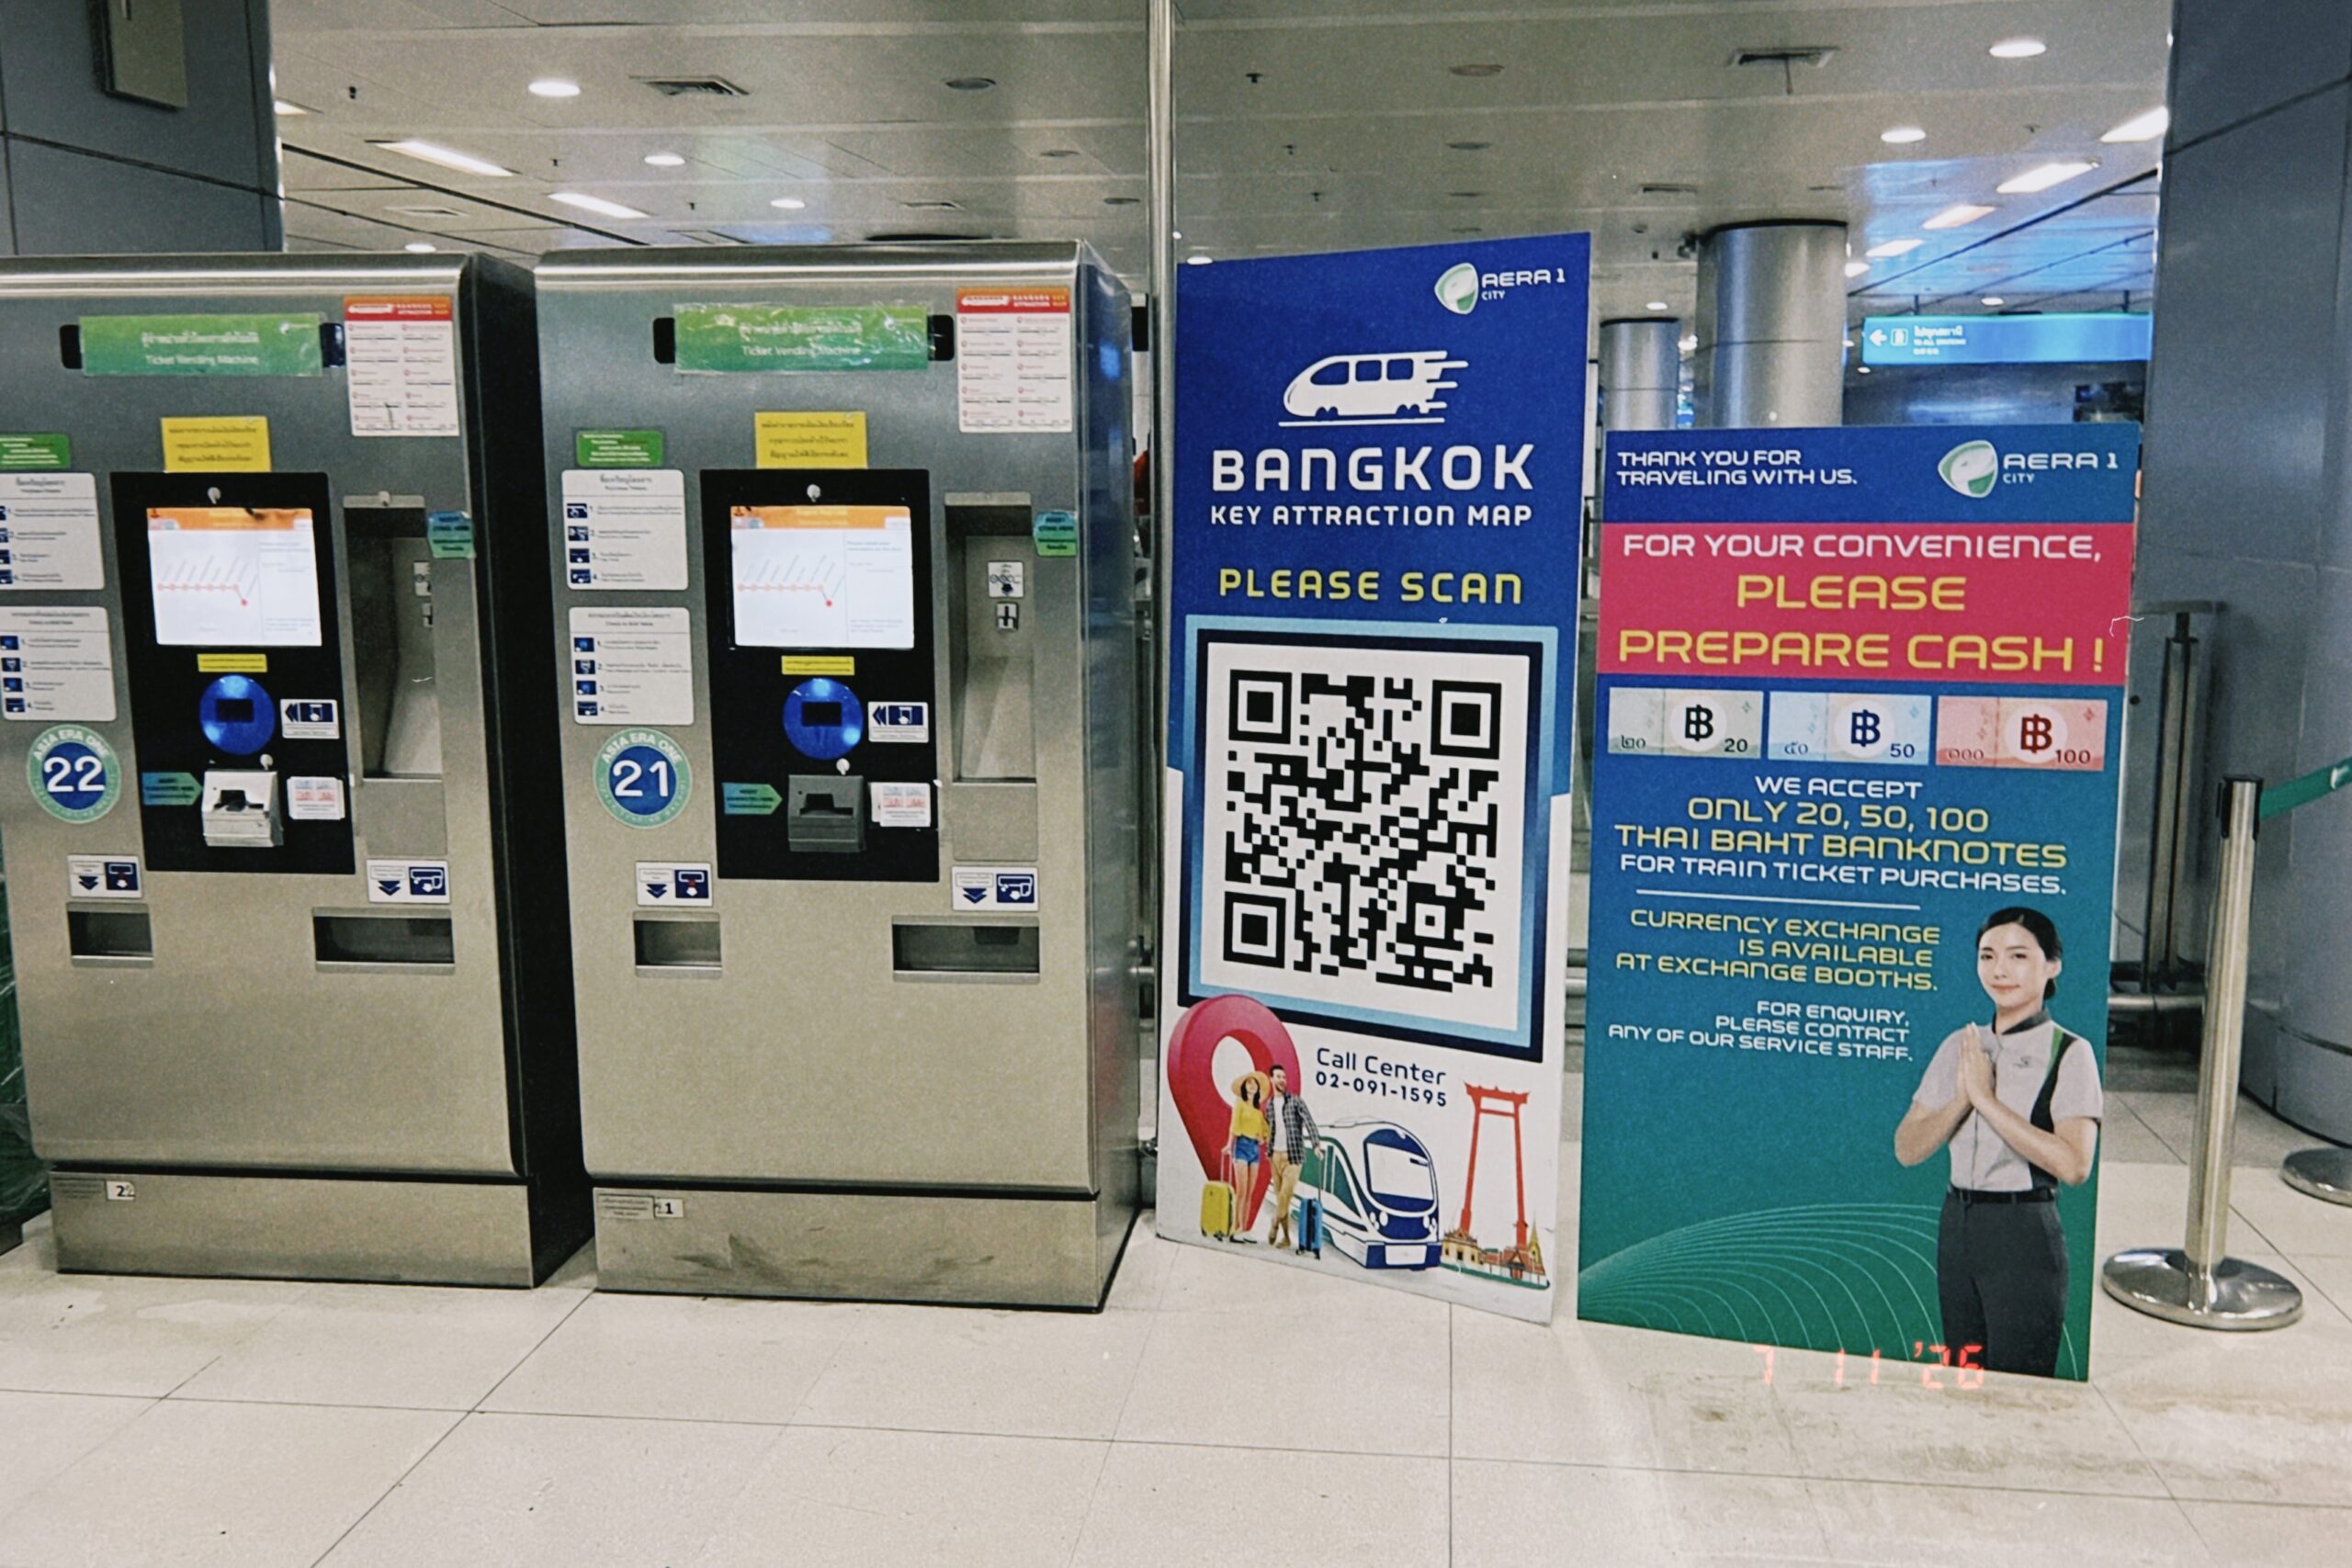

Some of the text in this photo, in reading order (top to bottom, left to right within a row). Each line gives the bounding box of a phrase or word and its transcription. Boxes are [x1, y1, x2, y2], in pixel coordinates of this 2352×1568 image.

[1481, 268, 1566, 288] AERA 1
[1481, 289, 1506, 300] CITY
[1212, 444, 1534, 491] BANGKOK
[1617, 449, 1802, 467] THANK YOU FOR
[2004, 452, 2118, 469] AERA 1
[1616, 468, 1858, 486] TRAVELING WITH US.
[2003, 473, 2035, 484] CITY
[1210, 505, 1532, 526] KEY ATTRACTION MAP
[1623, 535, 2102, 562] FOR YOUR CONVENIENCE,
[1219, 568, 1522, 604] PLEASE SCAN
[1736, 575, 1966, 610] PLEASE
[1619, 629, 2102, 672] PREPARE CASH !
[602, 732, 683, 765] ASIA ERA ONE
[1724, 738, 1748, 753] 20
[1890, 744, 1915, 759] 50
[2055, 749, 2091, 765] 100
[44, 756, 106, 793] 22
[613, 760, 669, 797] 21
[1755, 775, 1923, 801] WE ACCEPT
[1688, 797, 1989, 833] ONLY 20, 50, 100
[1614, 824, 2067, 868] THAI BAHT BANKNOTES
[1620, 854, 2067, 896] FOR TRAIN TICKET PURCHASES.
[1630, 908, 1940, 945] CURRENCY EXCHANGE
[1739, 938, 1933, 968] IS AVAILABLE
[1616, 953, 1939, 992] AT EXCHANGE BOOTHS.
[1715, 1015, 1910, 1043] PLEASE CONTACT
[1757, 1000, 1910, 1028] FOR ENQUIRY,
[1608, 1024, 1913, 1063] ANY OF OUR SERVICE STAFF.
[1317, 1047, 1446, 1085] Call Center
[1316, 1071, 1446, 1107] 02-091-1595
[665, 1202, 673, 1214] 1
